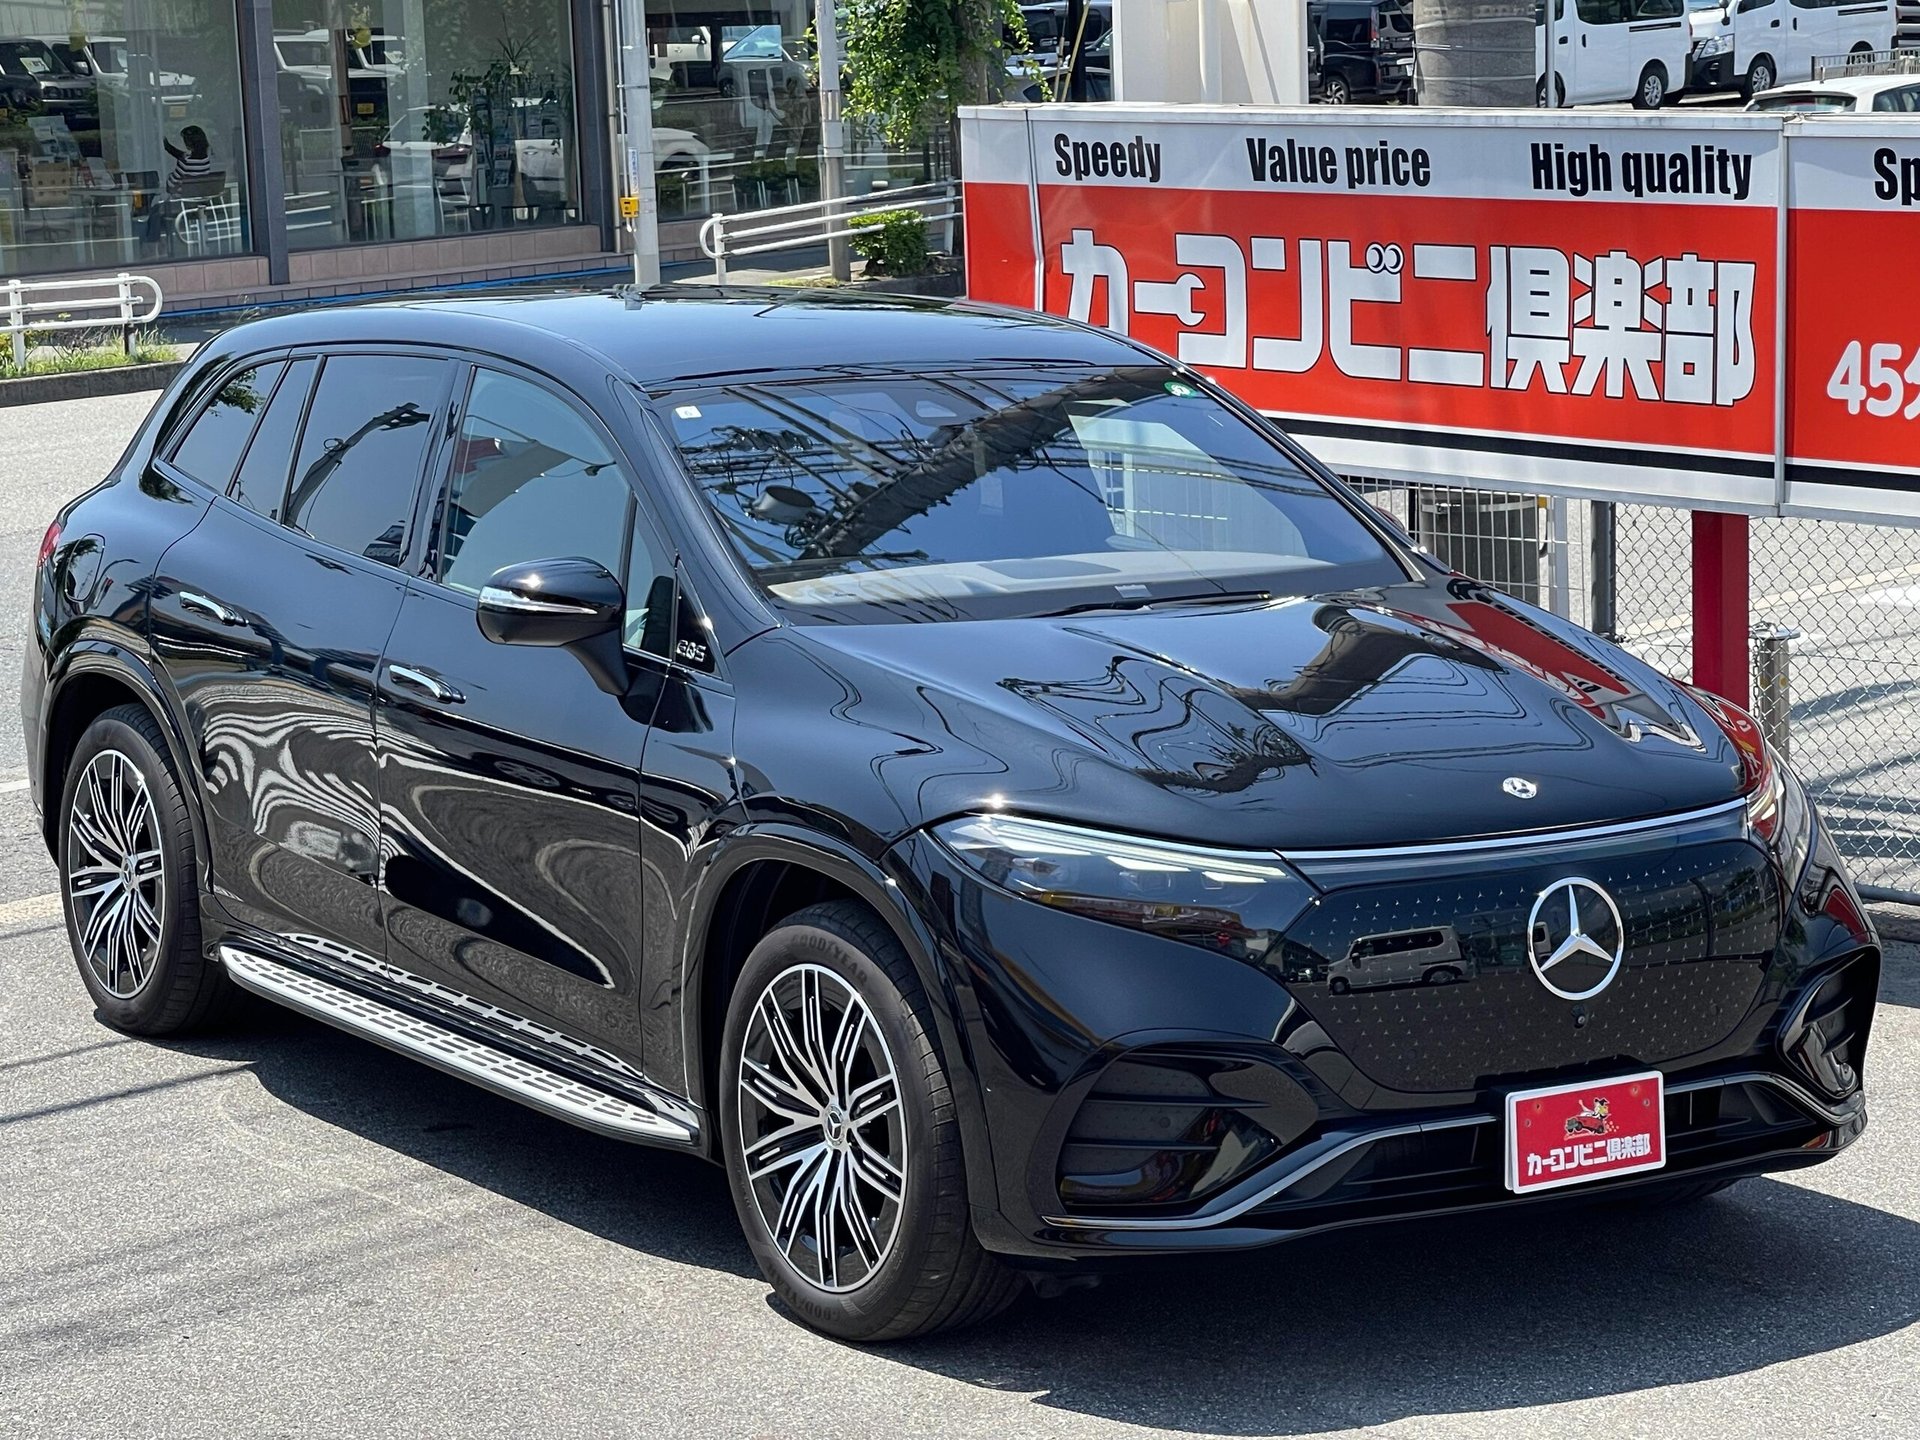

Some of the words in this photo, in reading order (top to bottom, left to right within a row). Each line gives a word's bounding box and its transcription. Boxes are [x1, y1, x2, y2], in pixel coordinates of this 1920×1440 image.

[1053, 132, 1161, 183] Speedy
[1245, 137, 1338, 184] Value
[1344, 140, 1431, 190] price
[1530, 142, 1613, 197] High
[1621, 144, 1753, 201] quality
[1060, 228, 1757, 408] カーコンビニ倶楽部
